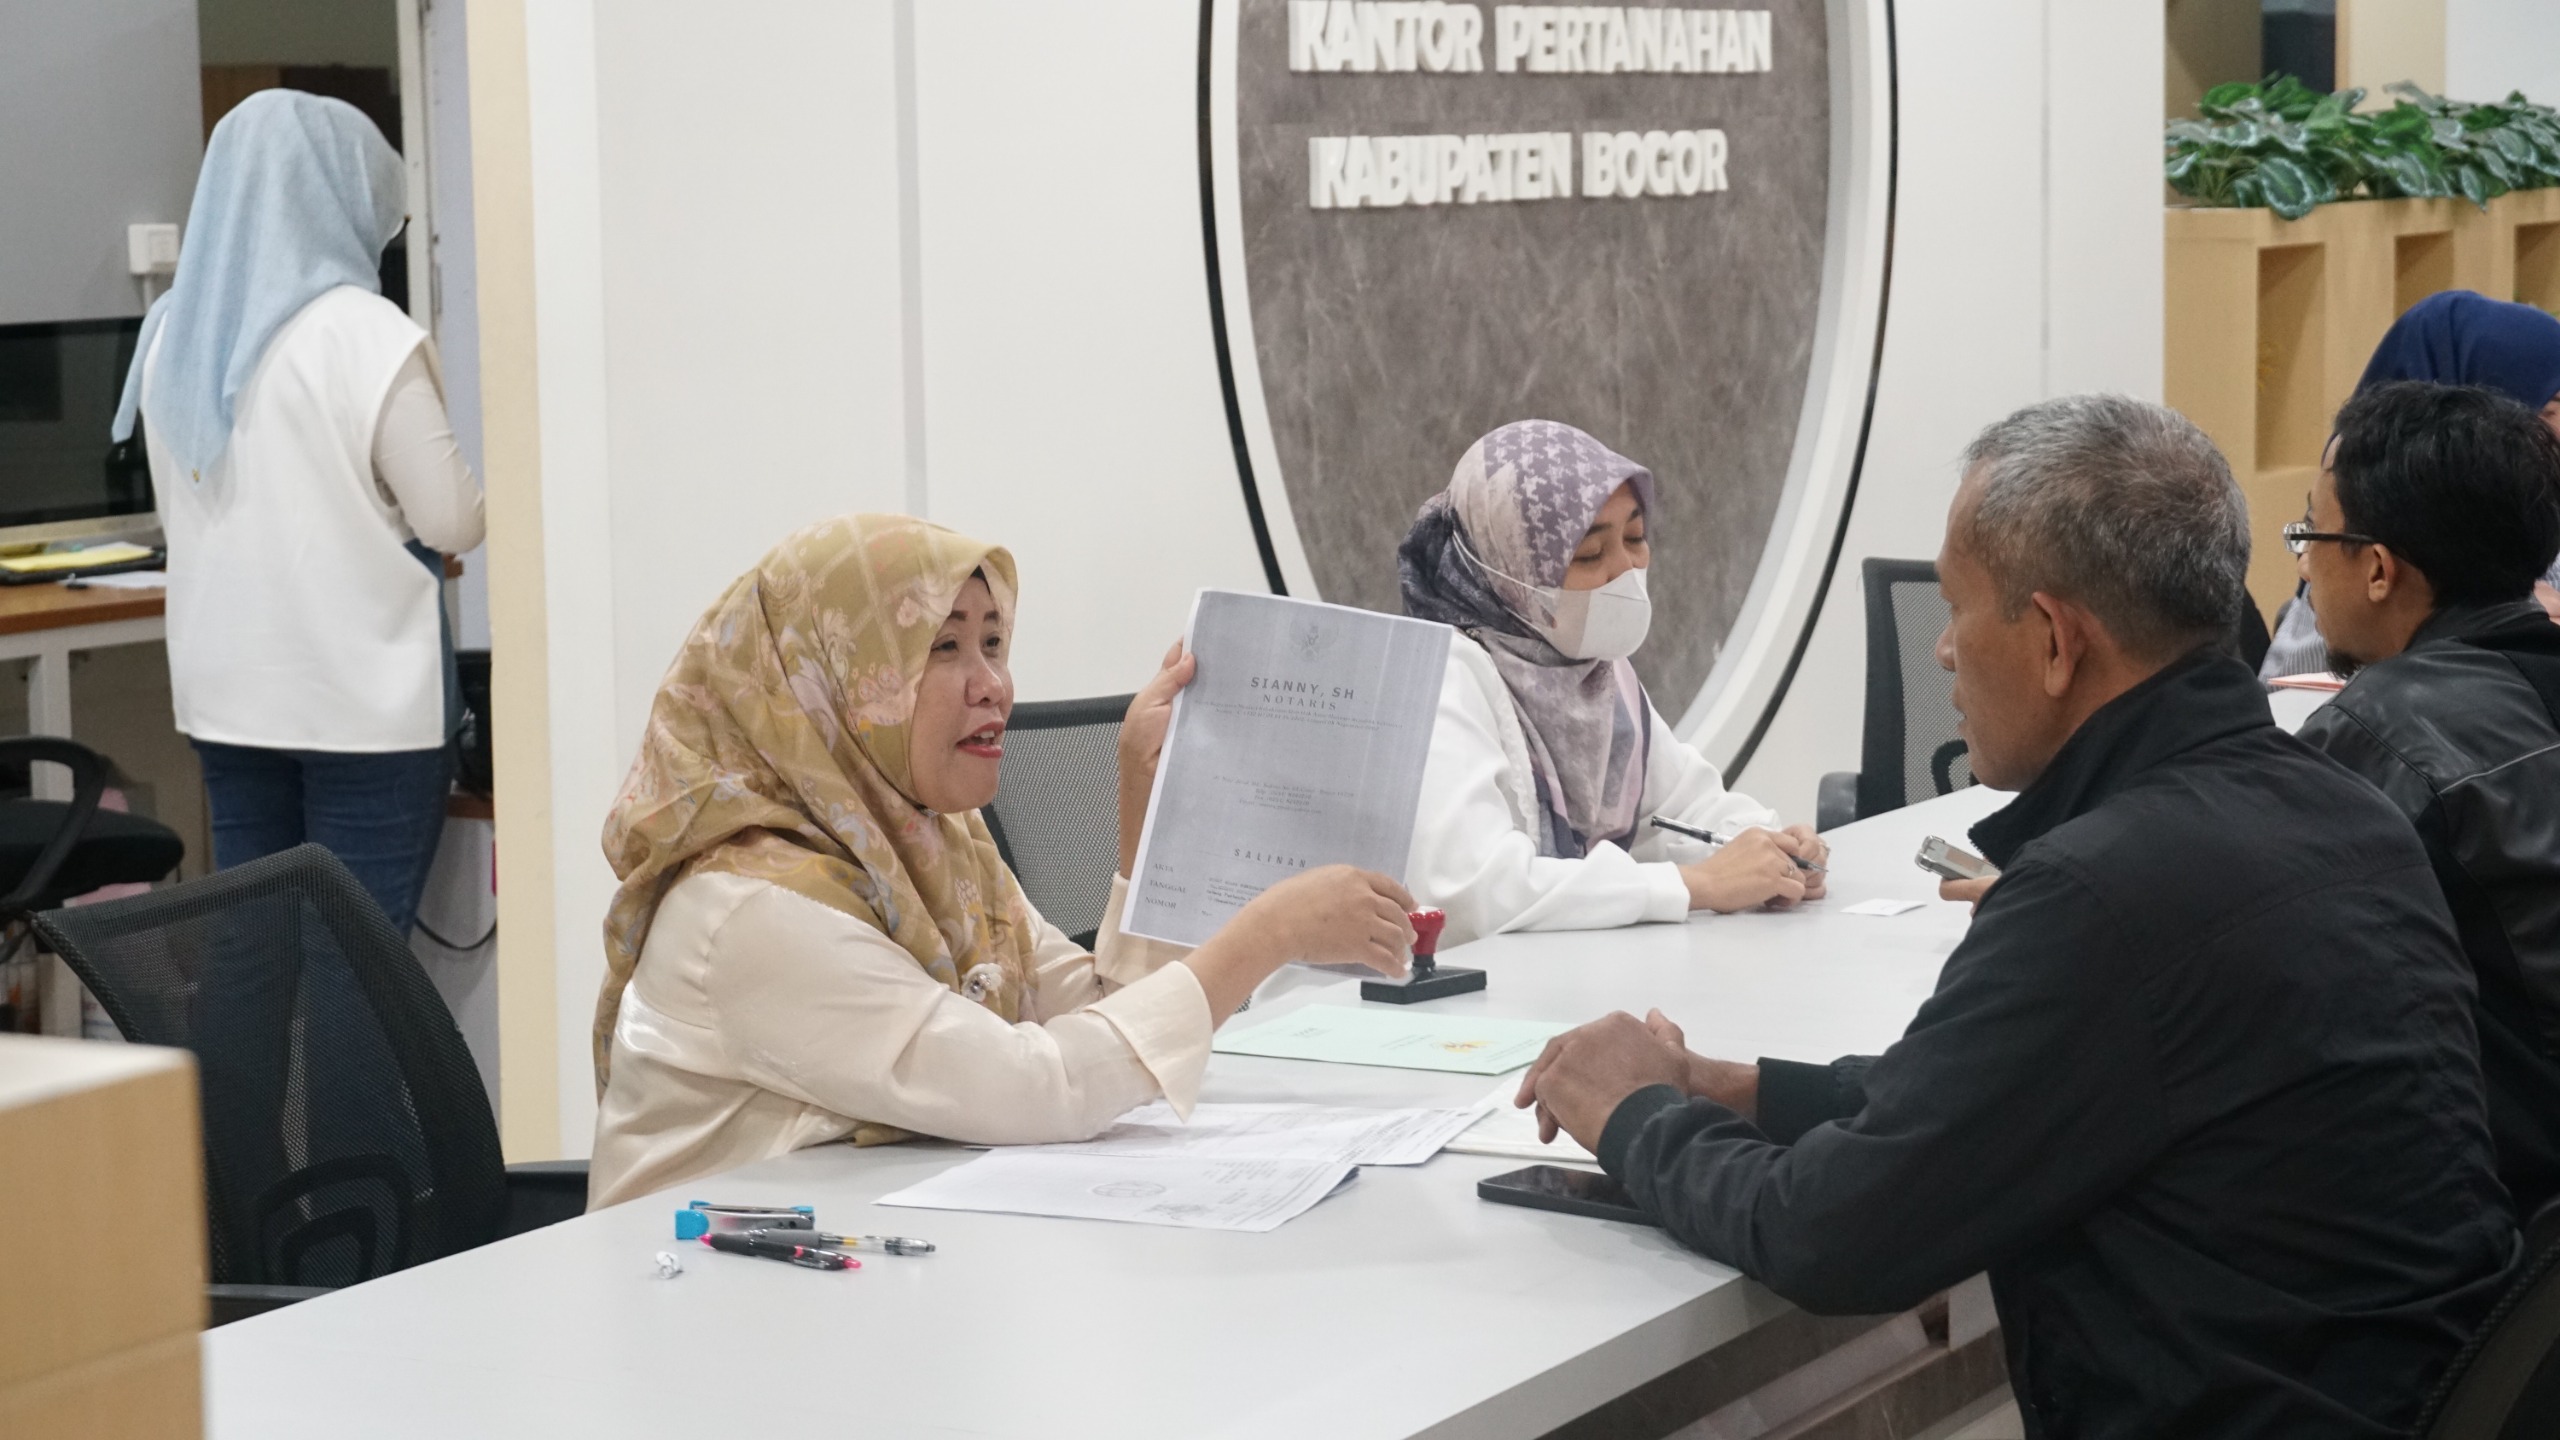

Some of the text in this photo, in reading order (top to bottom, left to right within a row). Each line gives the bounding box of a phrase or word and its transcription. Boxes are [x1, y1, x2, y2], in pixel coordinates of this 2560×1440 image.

[1288, 0, 1773, 74] KANTOR PERTANAHAN
[1308, 128, 1729, 210] KABUPATEN BOGOR
[1250, 676, 1355, 700] SIANNY, SH
[1263, 694, 1336, 711] NOTARIS
[1234, 848, 1306, 868] SALINAN
[1144, 896, 1177, 909] NOMOR
